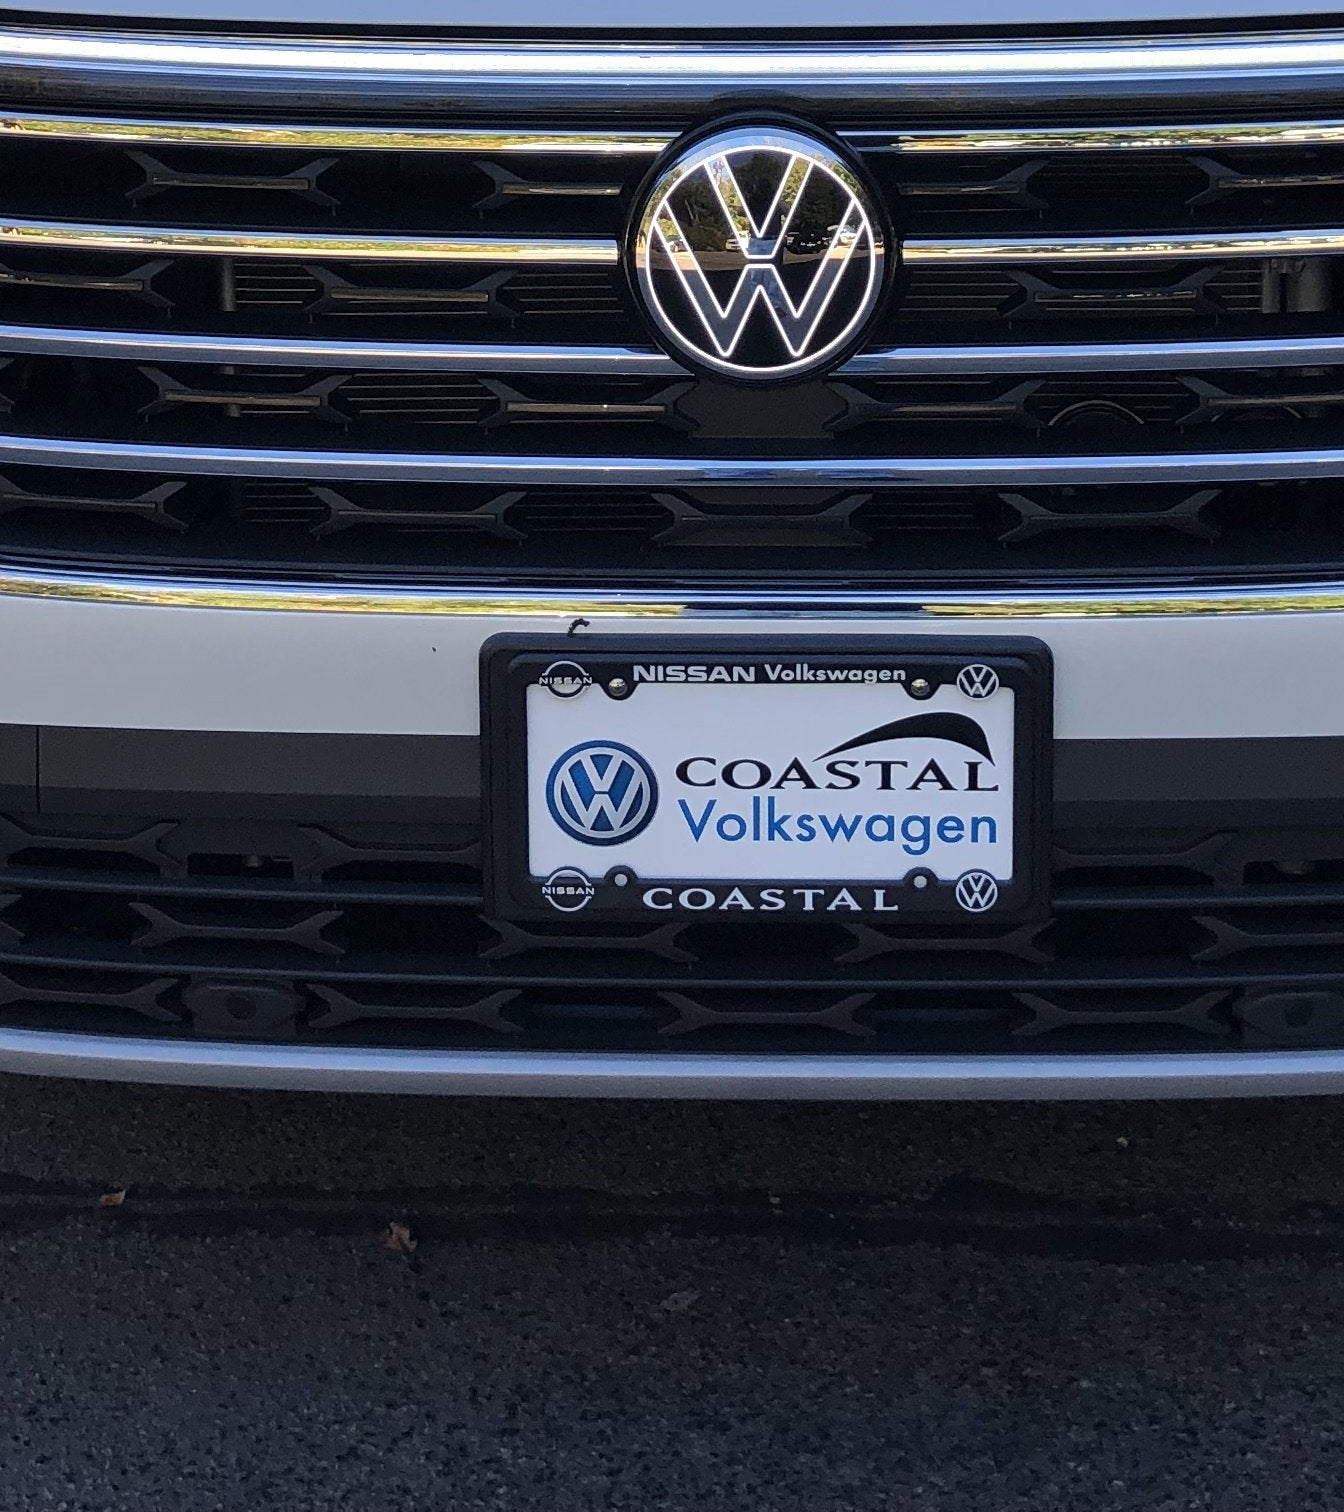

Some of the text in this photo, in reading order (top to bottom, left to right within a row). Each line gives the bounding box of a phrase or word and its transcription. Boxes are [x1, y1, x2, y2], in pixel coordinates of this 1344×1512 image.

[537, 676, 594, 686] NISSAN
[632, 662, 907, 684] NISSAN Volkswagen
[674, 756, 1000, 792] COASTAL
[677, 795, 998, 855] Volkswagen
[541, 885, 596, 897] NISSAN
[642, 886, 899, 912] COASTAL
